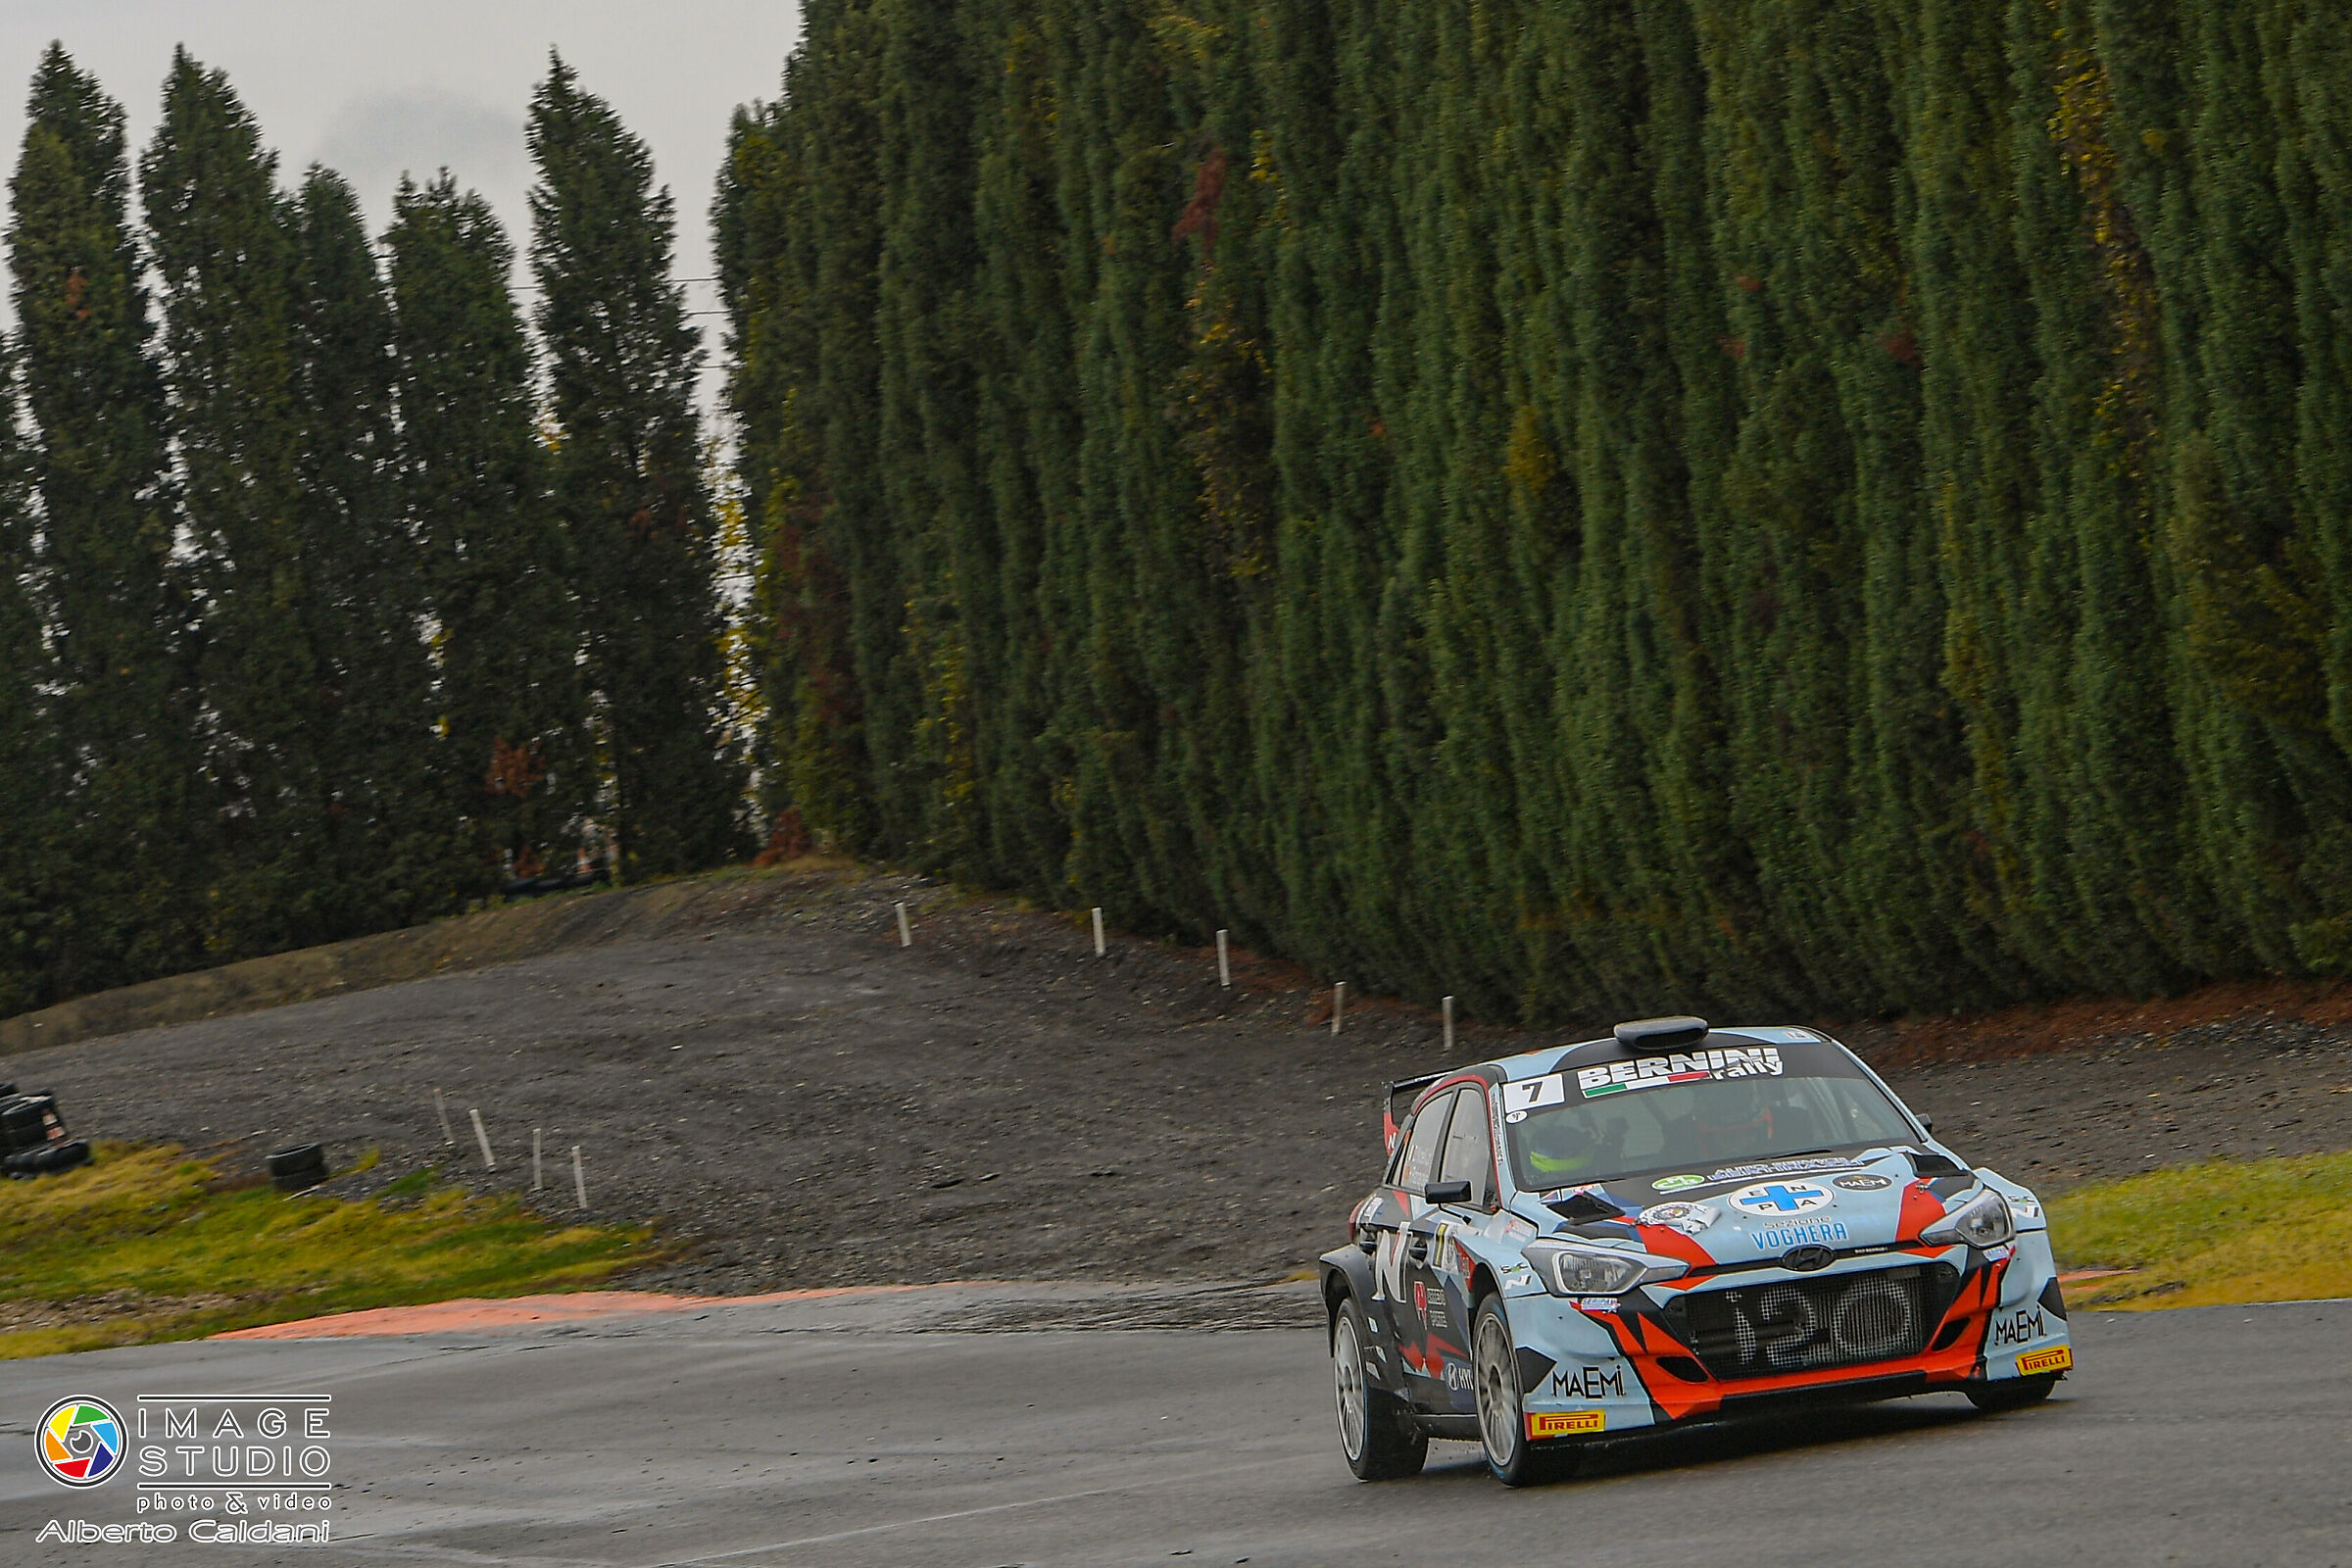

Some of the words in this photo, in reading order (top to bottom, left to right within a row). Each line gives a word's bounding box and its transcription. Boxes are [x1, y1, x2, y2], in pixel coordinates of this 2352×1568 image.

[1578, 1047, 1782, 1090] BERNINI
[1713, 1059, 1784, 1081] rally
[1521, 1081, 1544, 1103] 7
[1750, 1222, 1849, 1250] VOGHERA
[2021, 1349, 2065, 1371] PIRELLI
[1552, 1364, 1627, 1399] MAEMI
[1540, 1413, 1599, 1431] PIRELLI
